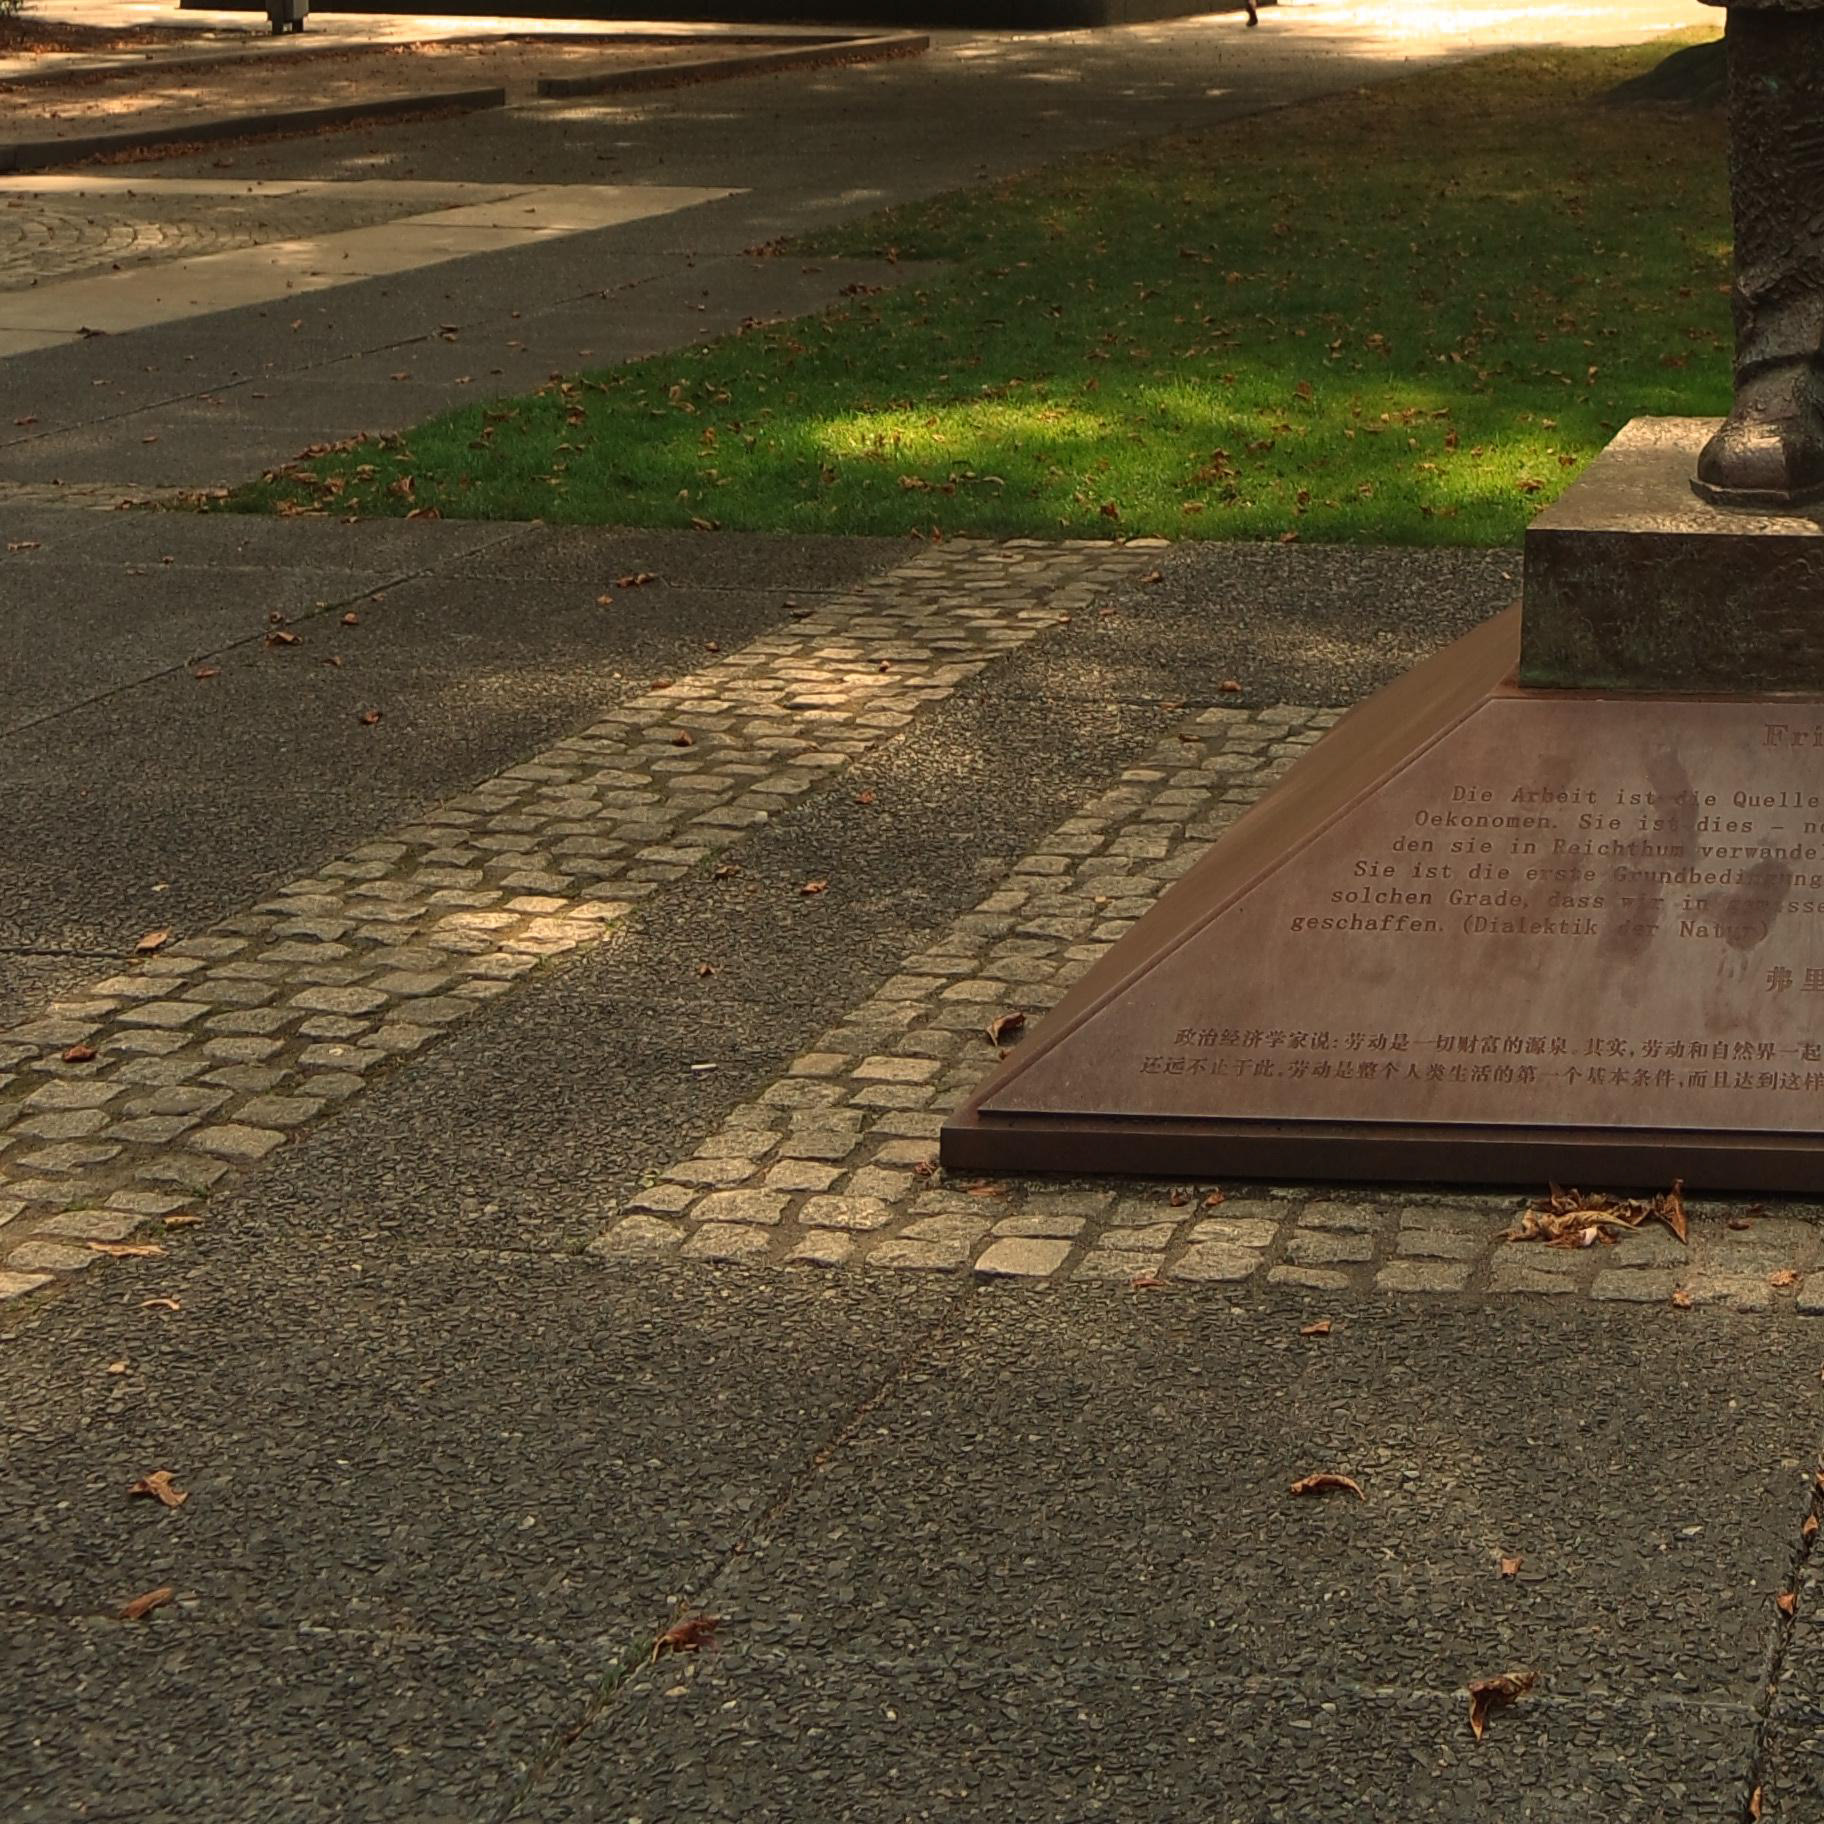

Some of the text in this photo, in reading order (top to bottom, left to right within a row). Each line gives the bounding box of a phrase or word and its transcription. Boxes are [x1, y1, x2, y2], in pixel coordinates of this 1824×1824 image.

[1453, 785, 1494, 804] Die
[1511, 786, 1598, 805] Arbeit
[1616, 788, 1656, 806] ist
[1675, 789, 1716, 808] die
[1733, 791, 1820, 811] Quelle
[1414, 810, 1559, 832] Oekonomen.
[1579, 814, 1620, 831] Sie
[1640, 814, 1680, 832] ist
[1697, 815, 1753, 834] dies
[1392, 835, 1434, 853] den
[1450, 837, 1492, 856] sie
[1511, 837, 1536, 856] in
[1553, 839, 1686, 859] Reichthum
[1354, 861, 1395, 878] Sie
[1411, 862, 1452, 880] ist
[1468, 862, 1509, 881] die
[1526, 866, 1595, 883] erste
[1613, 867, 1822, 892] Grundbedingung
[1331, 887, 1432, 907] solchen
[1449, 889, 1528, 911] Grade,
[1548, 891, 1604, 910] dass
[1622, 893, 1664, 912] wir
[1683, 893, 1706, 913] in
[1290, 912, 1770, 942] geschaffen. (Dialektik der Natur)
